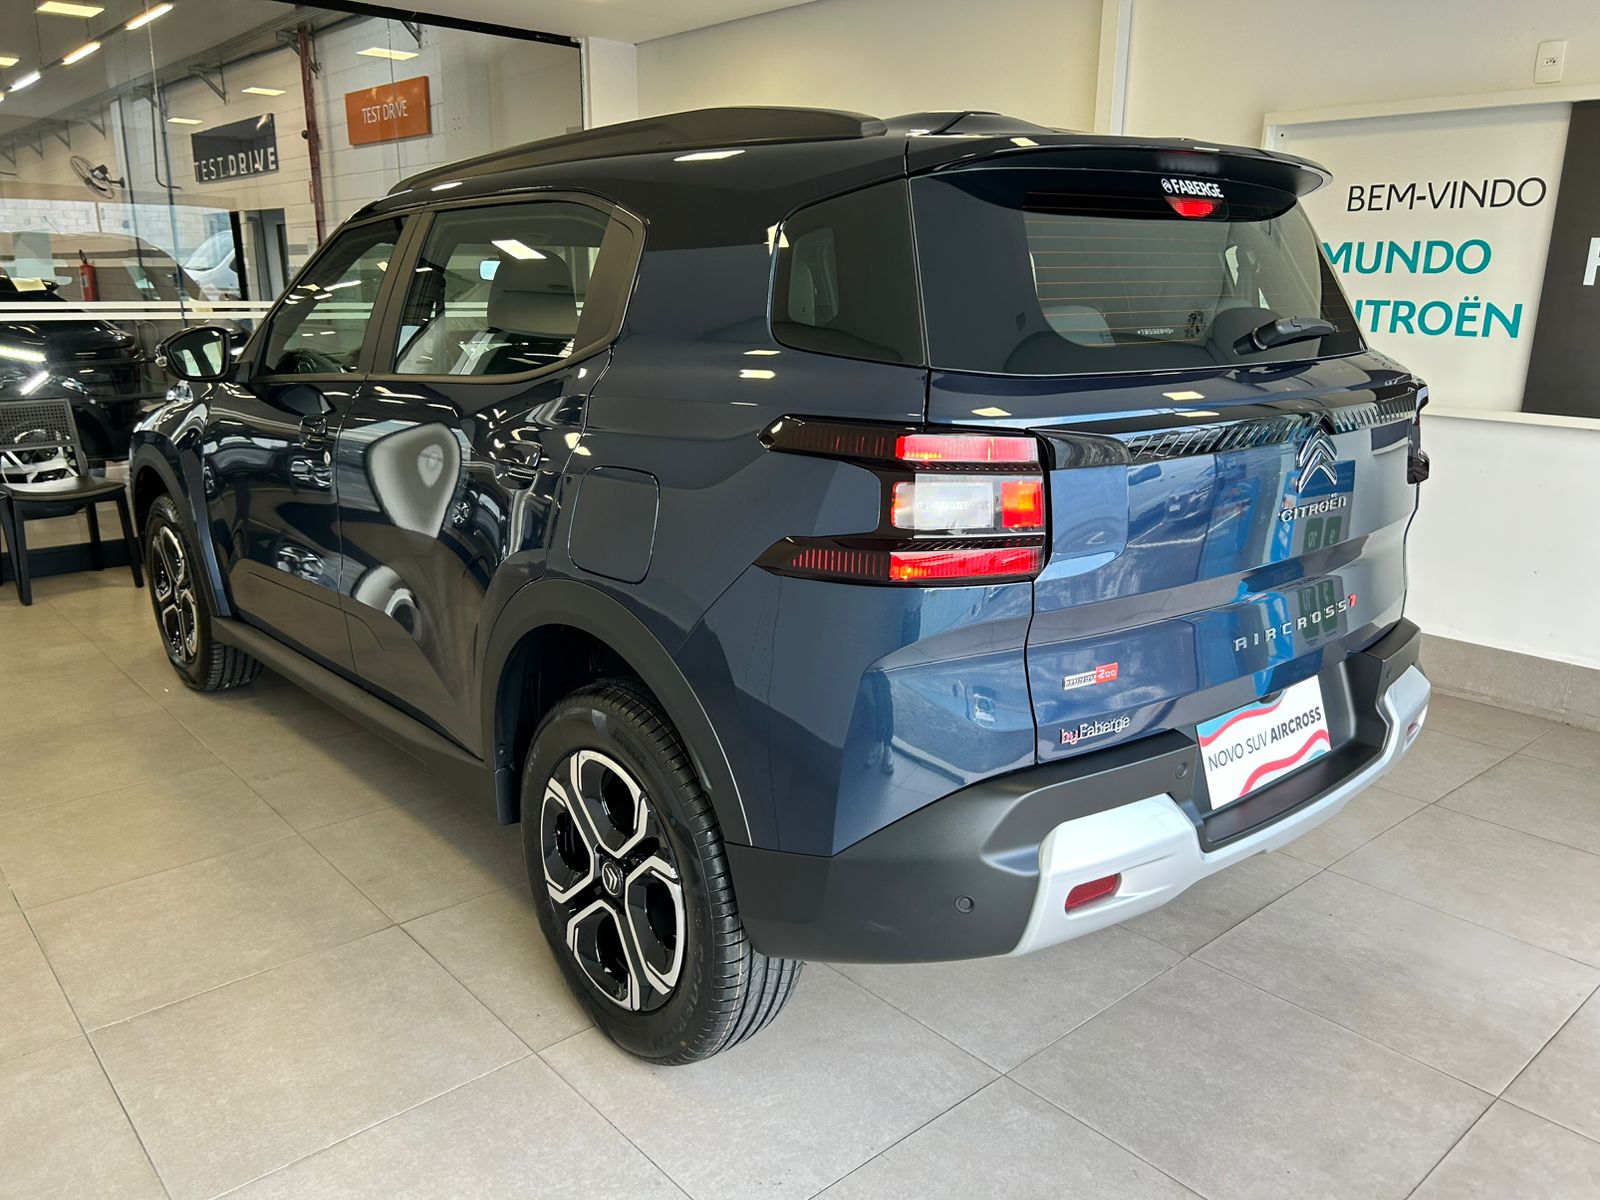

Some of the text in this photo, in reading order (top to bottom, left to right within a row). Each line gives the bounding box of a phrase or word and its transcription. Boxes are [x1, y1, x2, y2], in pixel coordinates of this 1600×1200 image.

[361, 105, 381, 124] TEST
[194, 147, 276, 180] TEST DRIVE
[1170, 179, 1224, 198] FABERGE
[1347, 177, 1546, 211] BEM-VINDO
[1322, 239, 1492, 274] MUNDO
[1355, 295, 1523, 339] ITROËN
[1208, 706, 1321, 771] NOVO SUV AIRCROSS
